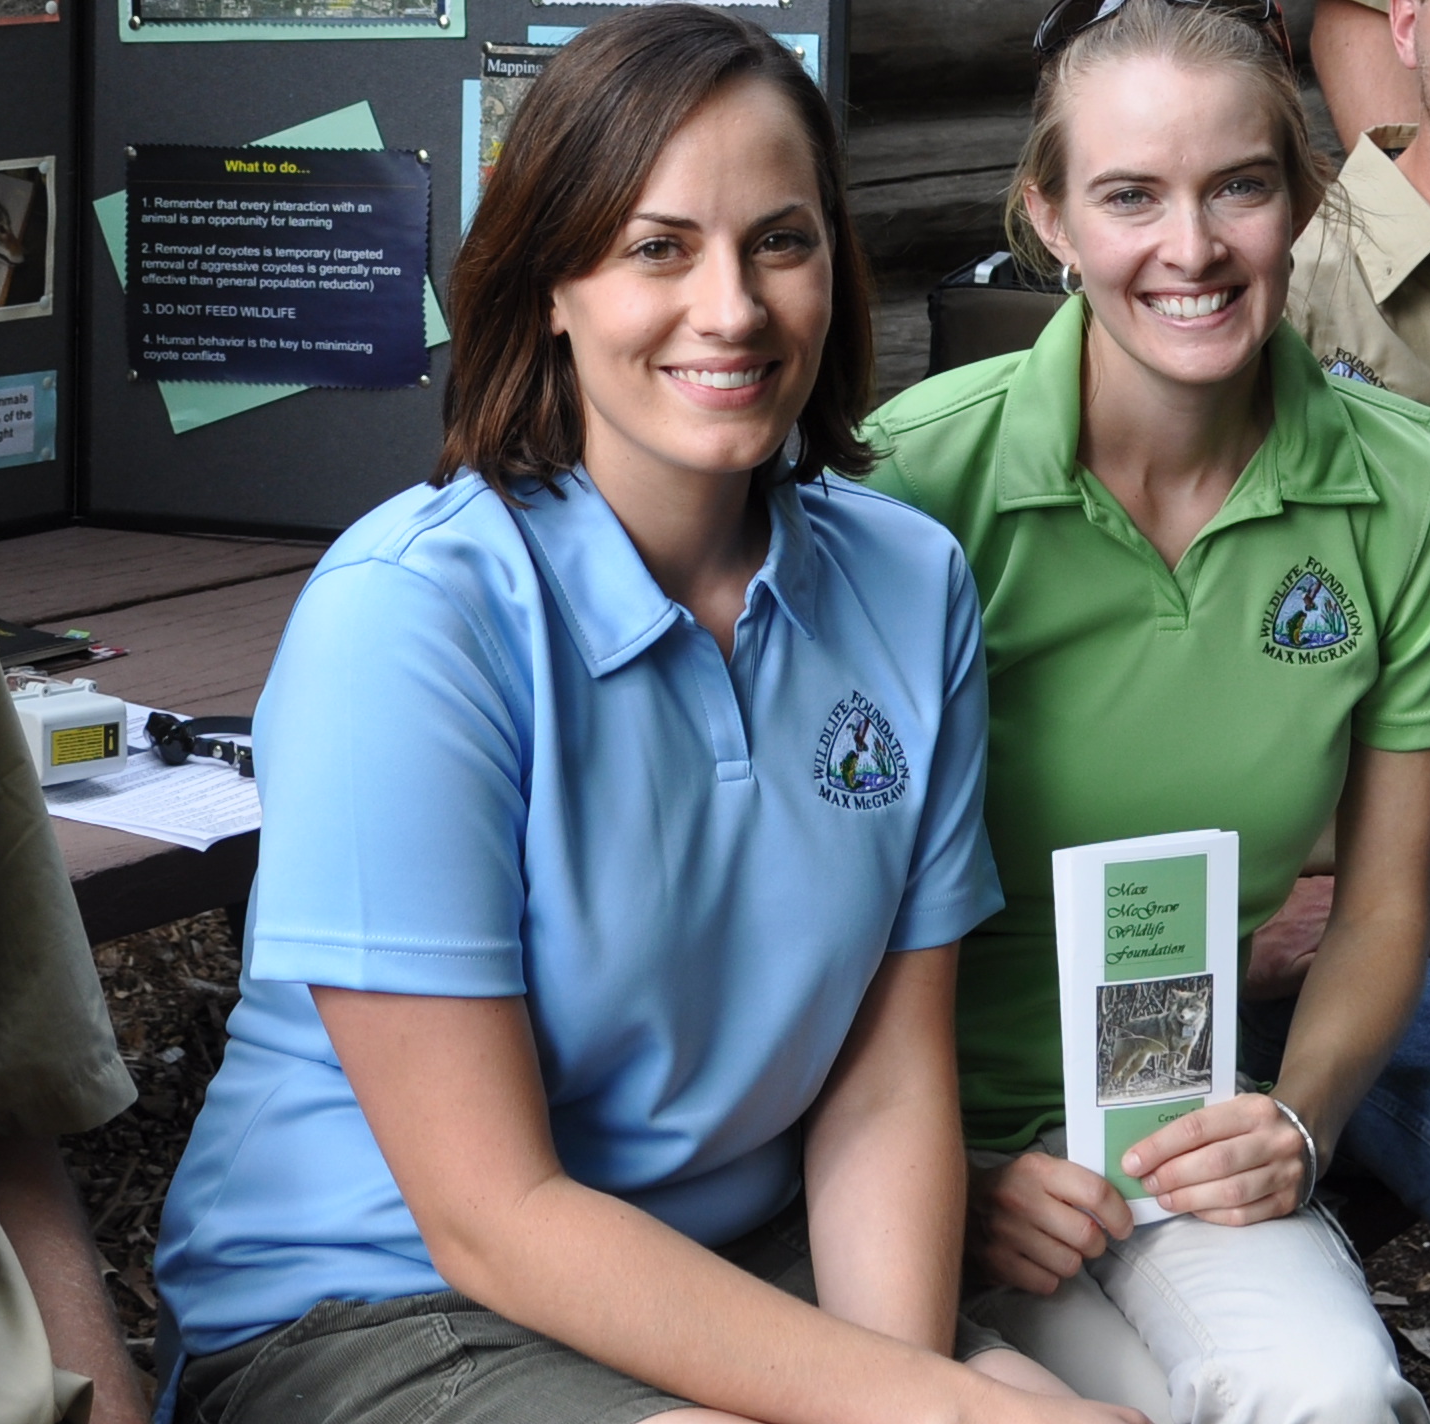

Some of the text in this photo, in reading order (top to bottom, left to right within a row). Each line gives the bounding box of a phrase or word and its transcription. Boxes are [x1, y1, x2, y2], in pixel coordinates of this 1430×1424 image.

[224, 160, 259, 172] What
[262, 161, 276, 173] to
[142, 196, 372, 212] 1. Remember that every interaction with an
[141, 213, 332, 230] animal is an opportunity for learning
[142, 302, 296, 318] 3. DO NOT FEED WILDLIFE
[142, 333, 373, 354] 4. Human behavior is the key to minimizing
[143, 350, 226, 361] coyote conflicts
[3, 410, 14, 422] of
[15, 409, 32, 420] the
[1260, 555, 1363, 638] WILDLIFE FOUNDATION
[1261, 637, 1357, 665] MAX McGRAW
[813, 689, 911, 780] WILDLIFE FOUNDATION
[818, 780, 907, 810] MAX McGRAW
[1107, 882, 1148, 898] Max
[1107, 900, 1179, 920] McGraw
[1107, 922, 1165, 940] Wildlife
[1106, 943, 1185, 965] Foundation
